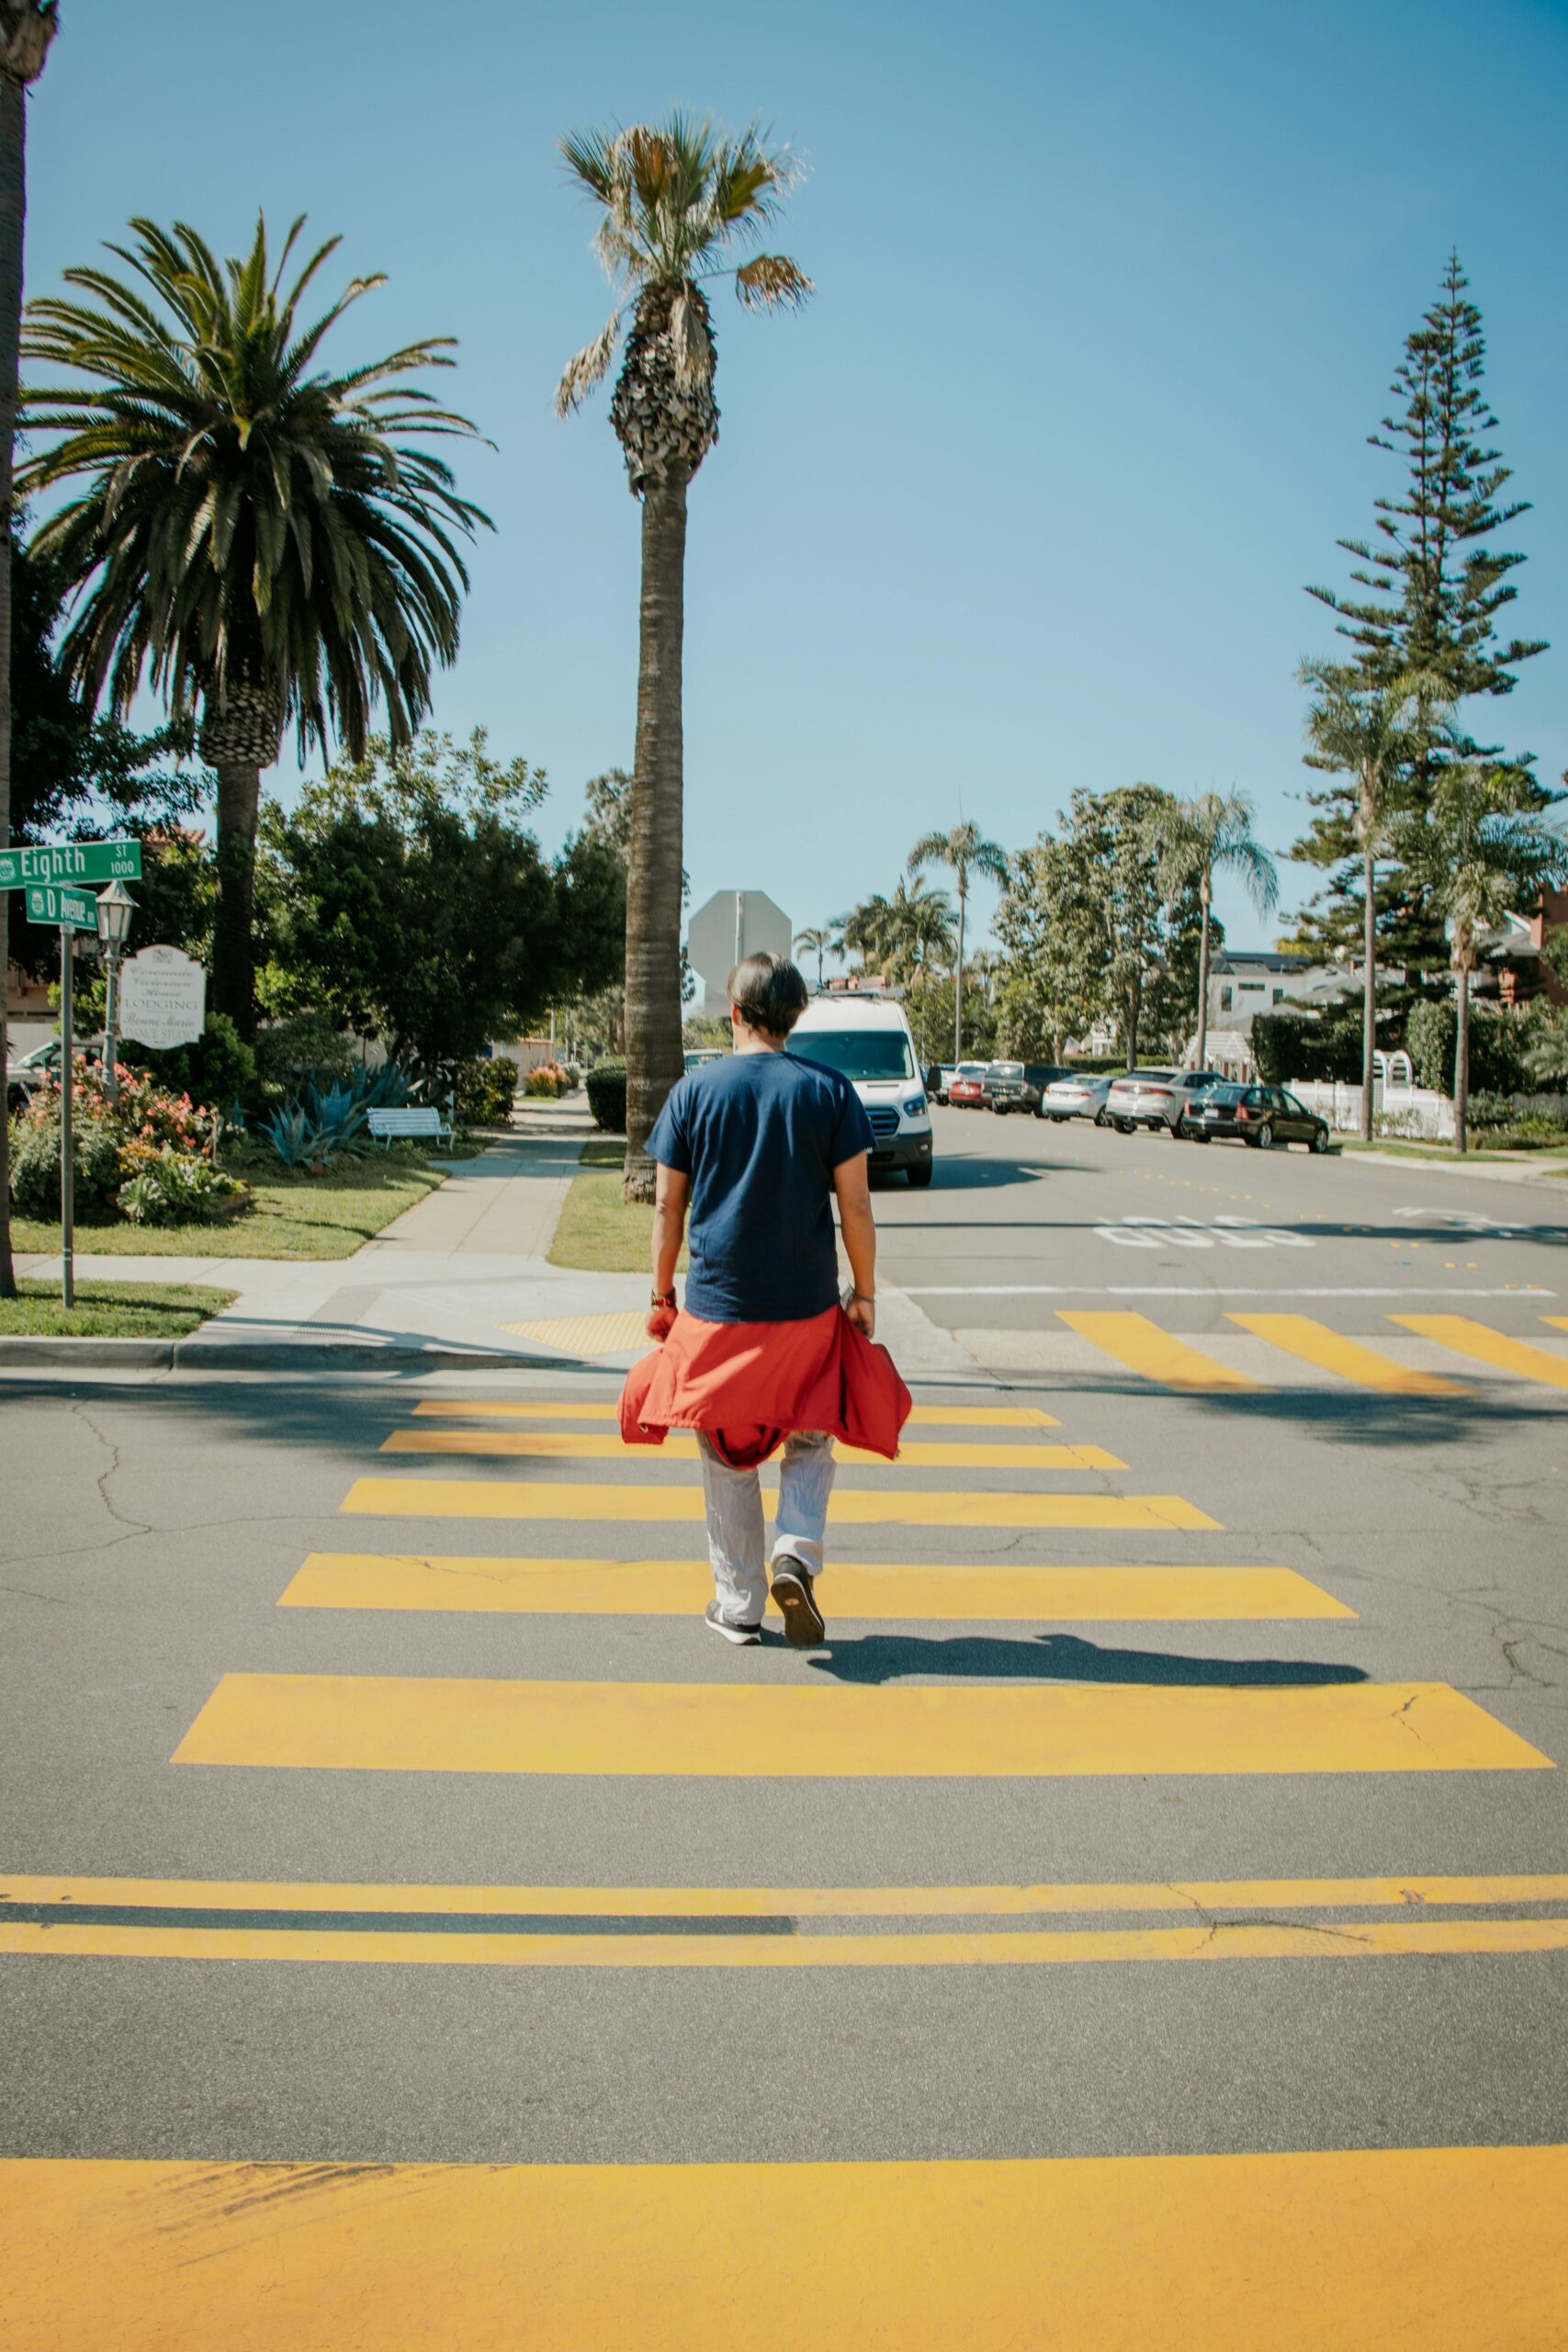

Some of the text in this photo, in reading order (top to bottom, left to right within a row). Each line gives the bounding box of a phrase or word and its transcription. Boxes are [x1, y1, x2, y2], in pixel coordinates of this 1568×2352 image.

[116, 844, 127, 858] ST
[20, 847, 85, 883] Eighth
[110, 860, 134, 875] 1000
[46, 888, 56, 918] D
[60, 891, 85, 922] Avenue
[125, 999, 197, 1012] LODGING
[125, 1028, 196, 1040] DANCE STUDIO
